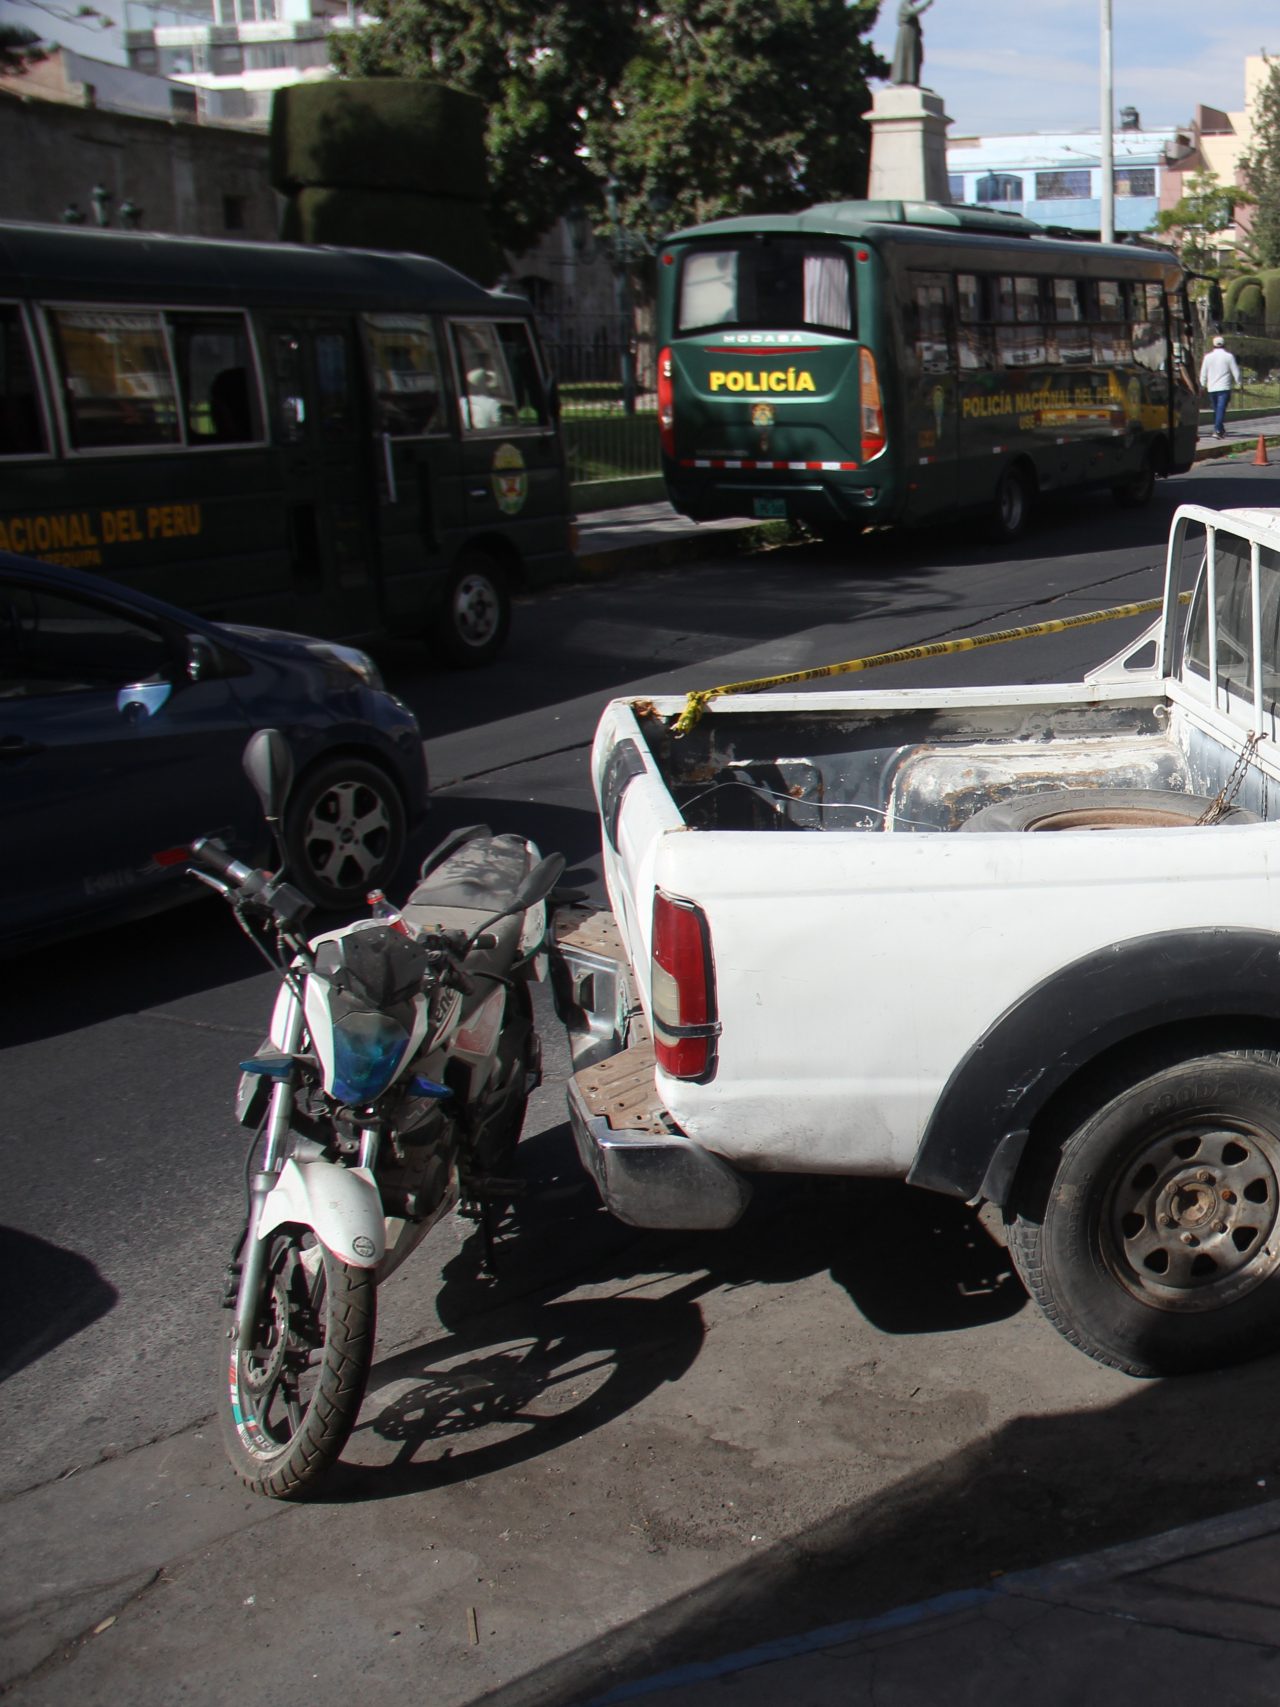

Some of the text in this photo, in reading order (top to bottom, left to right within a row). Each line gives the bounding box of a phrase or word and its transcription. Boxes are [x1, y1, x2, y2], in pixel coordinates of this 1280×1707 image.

[709, 366, 816, 392] POLICÍA
[962, 390, 1012, 418] POLICÍA
[1016, 390, 1072, 413] NACIONAL
[101, 510, 143, 542] DEL
[147, 505, 201, 538] PERU
